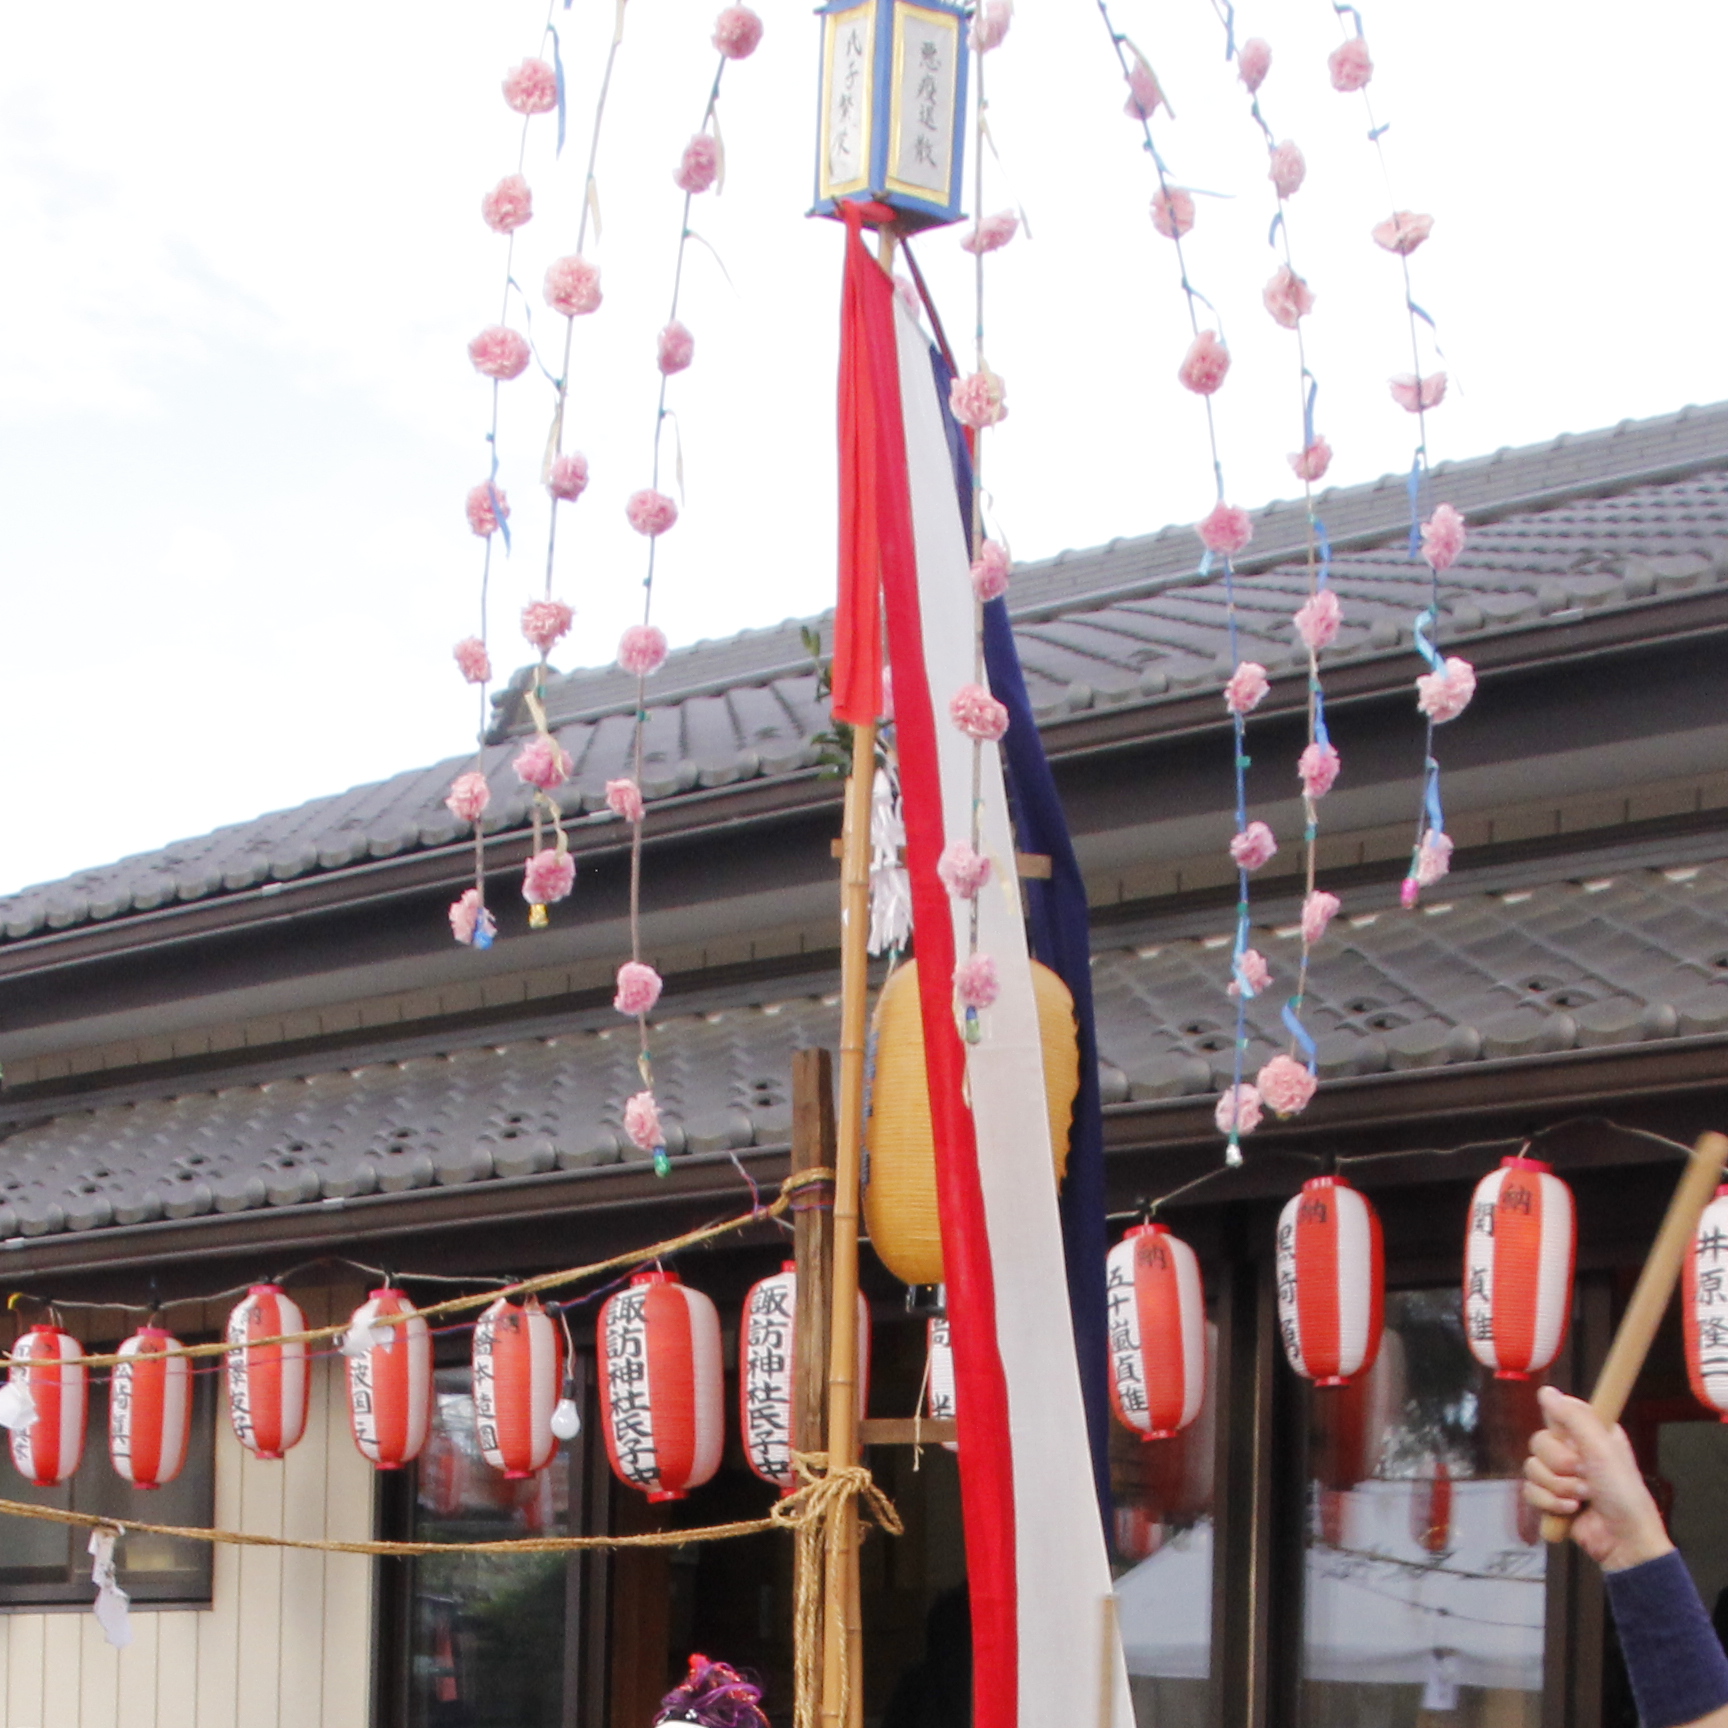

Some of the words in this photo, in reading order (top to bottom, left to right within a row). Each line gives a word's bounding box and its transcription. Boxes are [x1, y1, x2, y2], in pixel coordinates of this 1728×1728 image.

[606, 1290, 661, 1485] 諏訪神社氏子中
[748, 1283, 792, 1480] 諏訪神社氏子中
